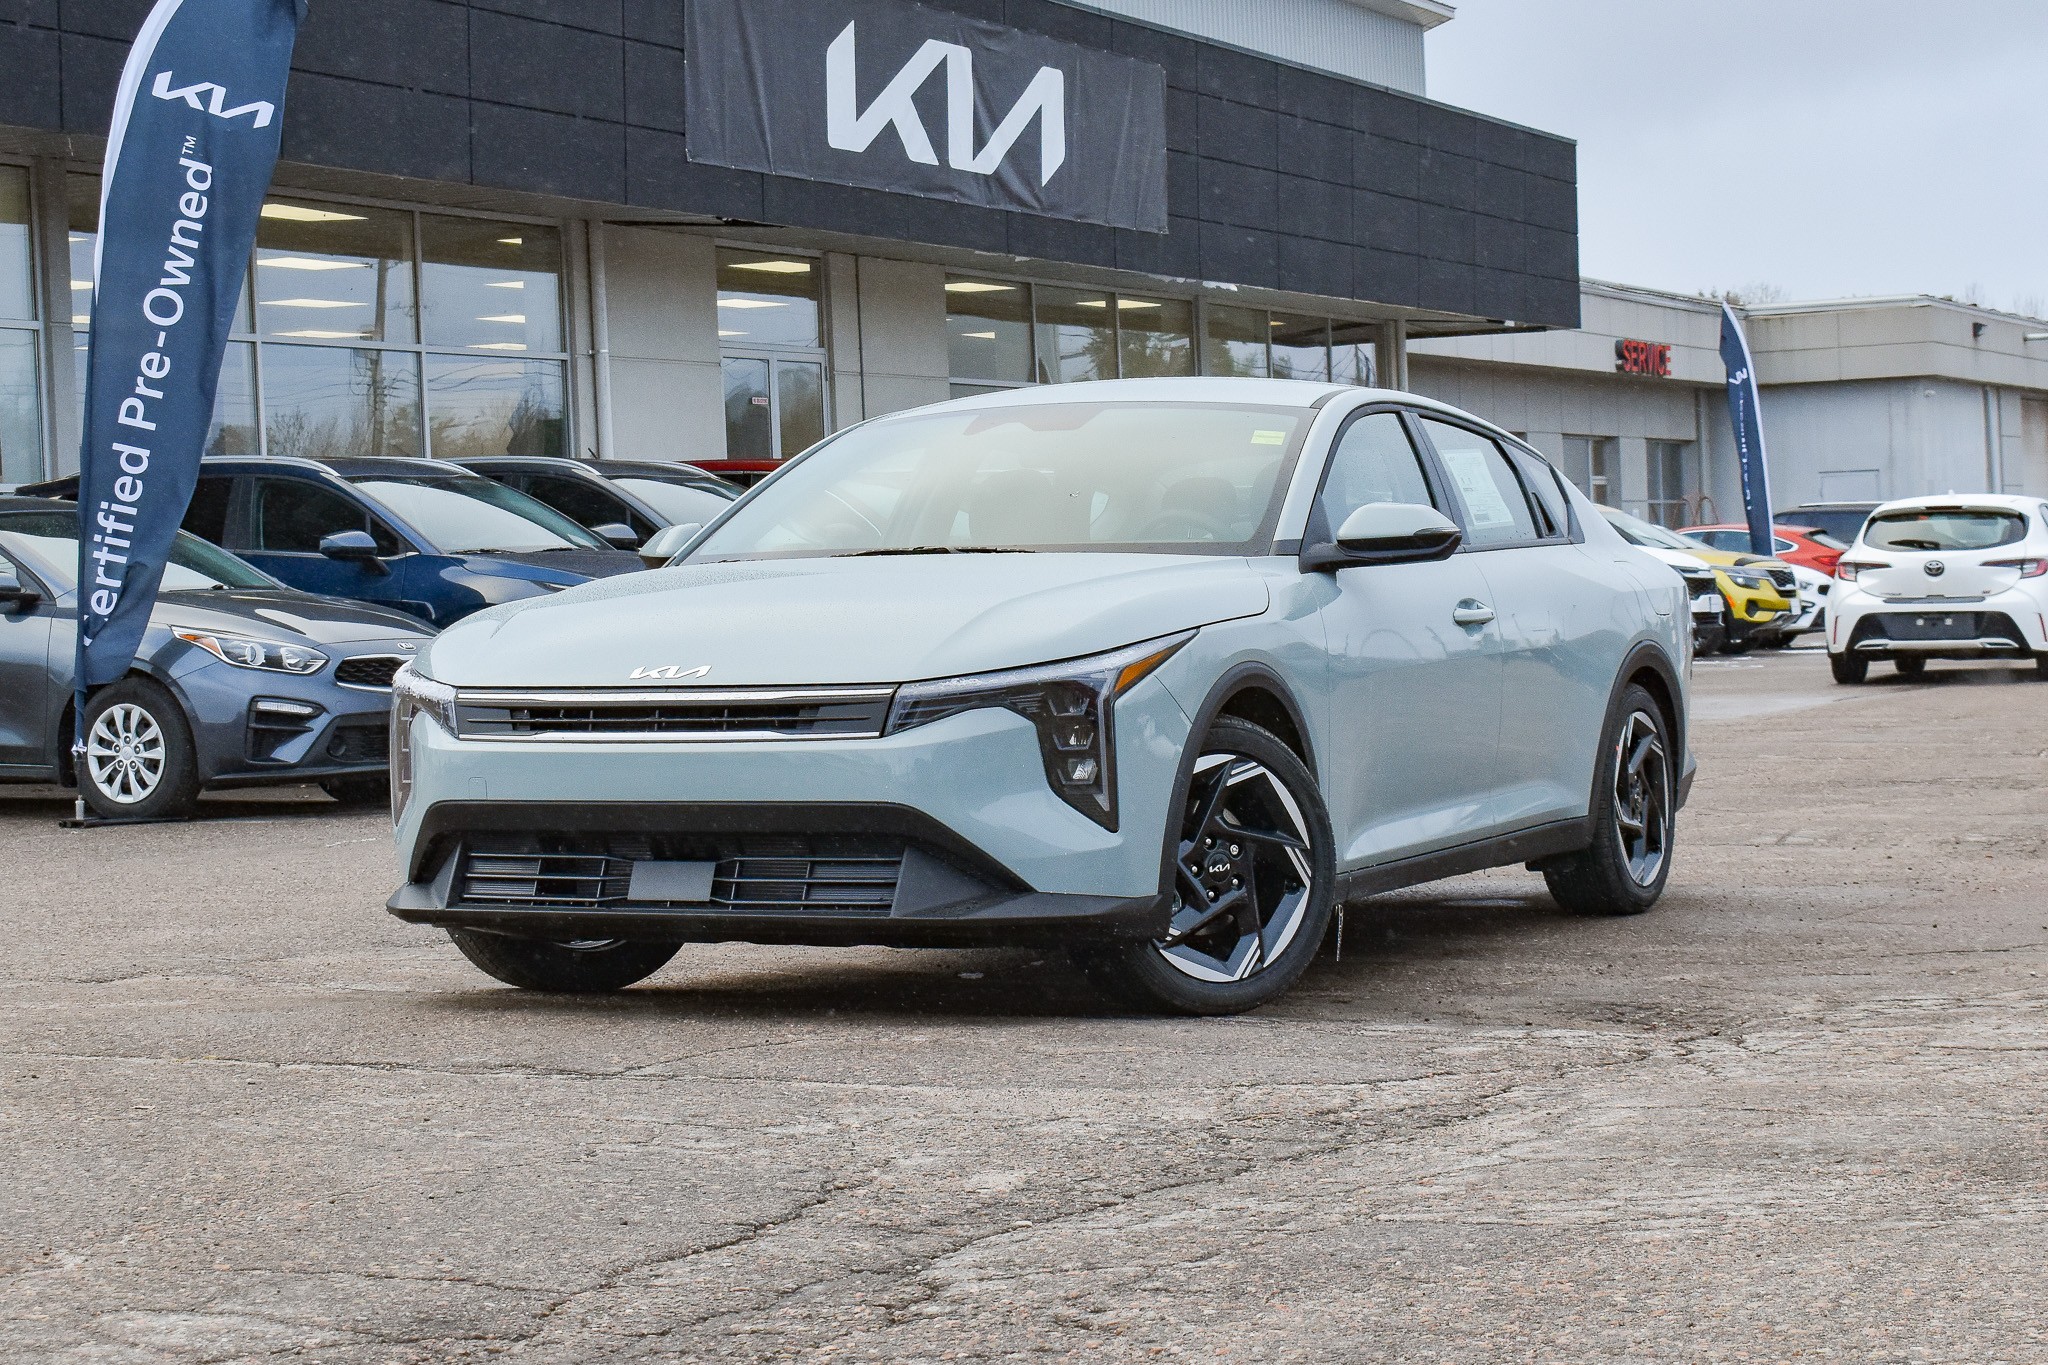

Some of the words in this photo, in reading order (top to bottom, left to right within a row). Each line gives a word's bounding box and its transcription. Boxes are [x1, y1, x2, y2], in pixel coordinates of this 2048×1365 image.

[827, 20, 1065, 187] KIA
[1621, 339, 1671, 376] SERVICE
[629, 665, 712, 680] KIA
